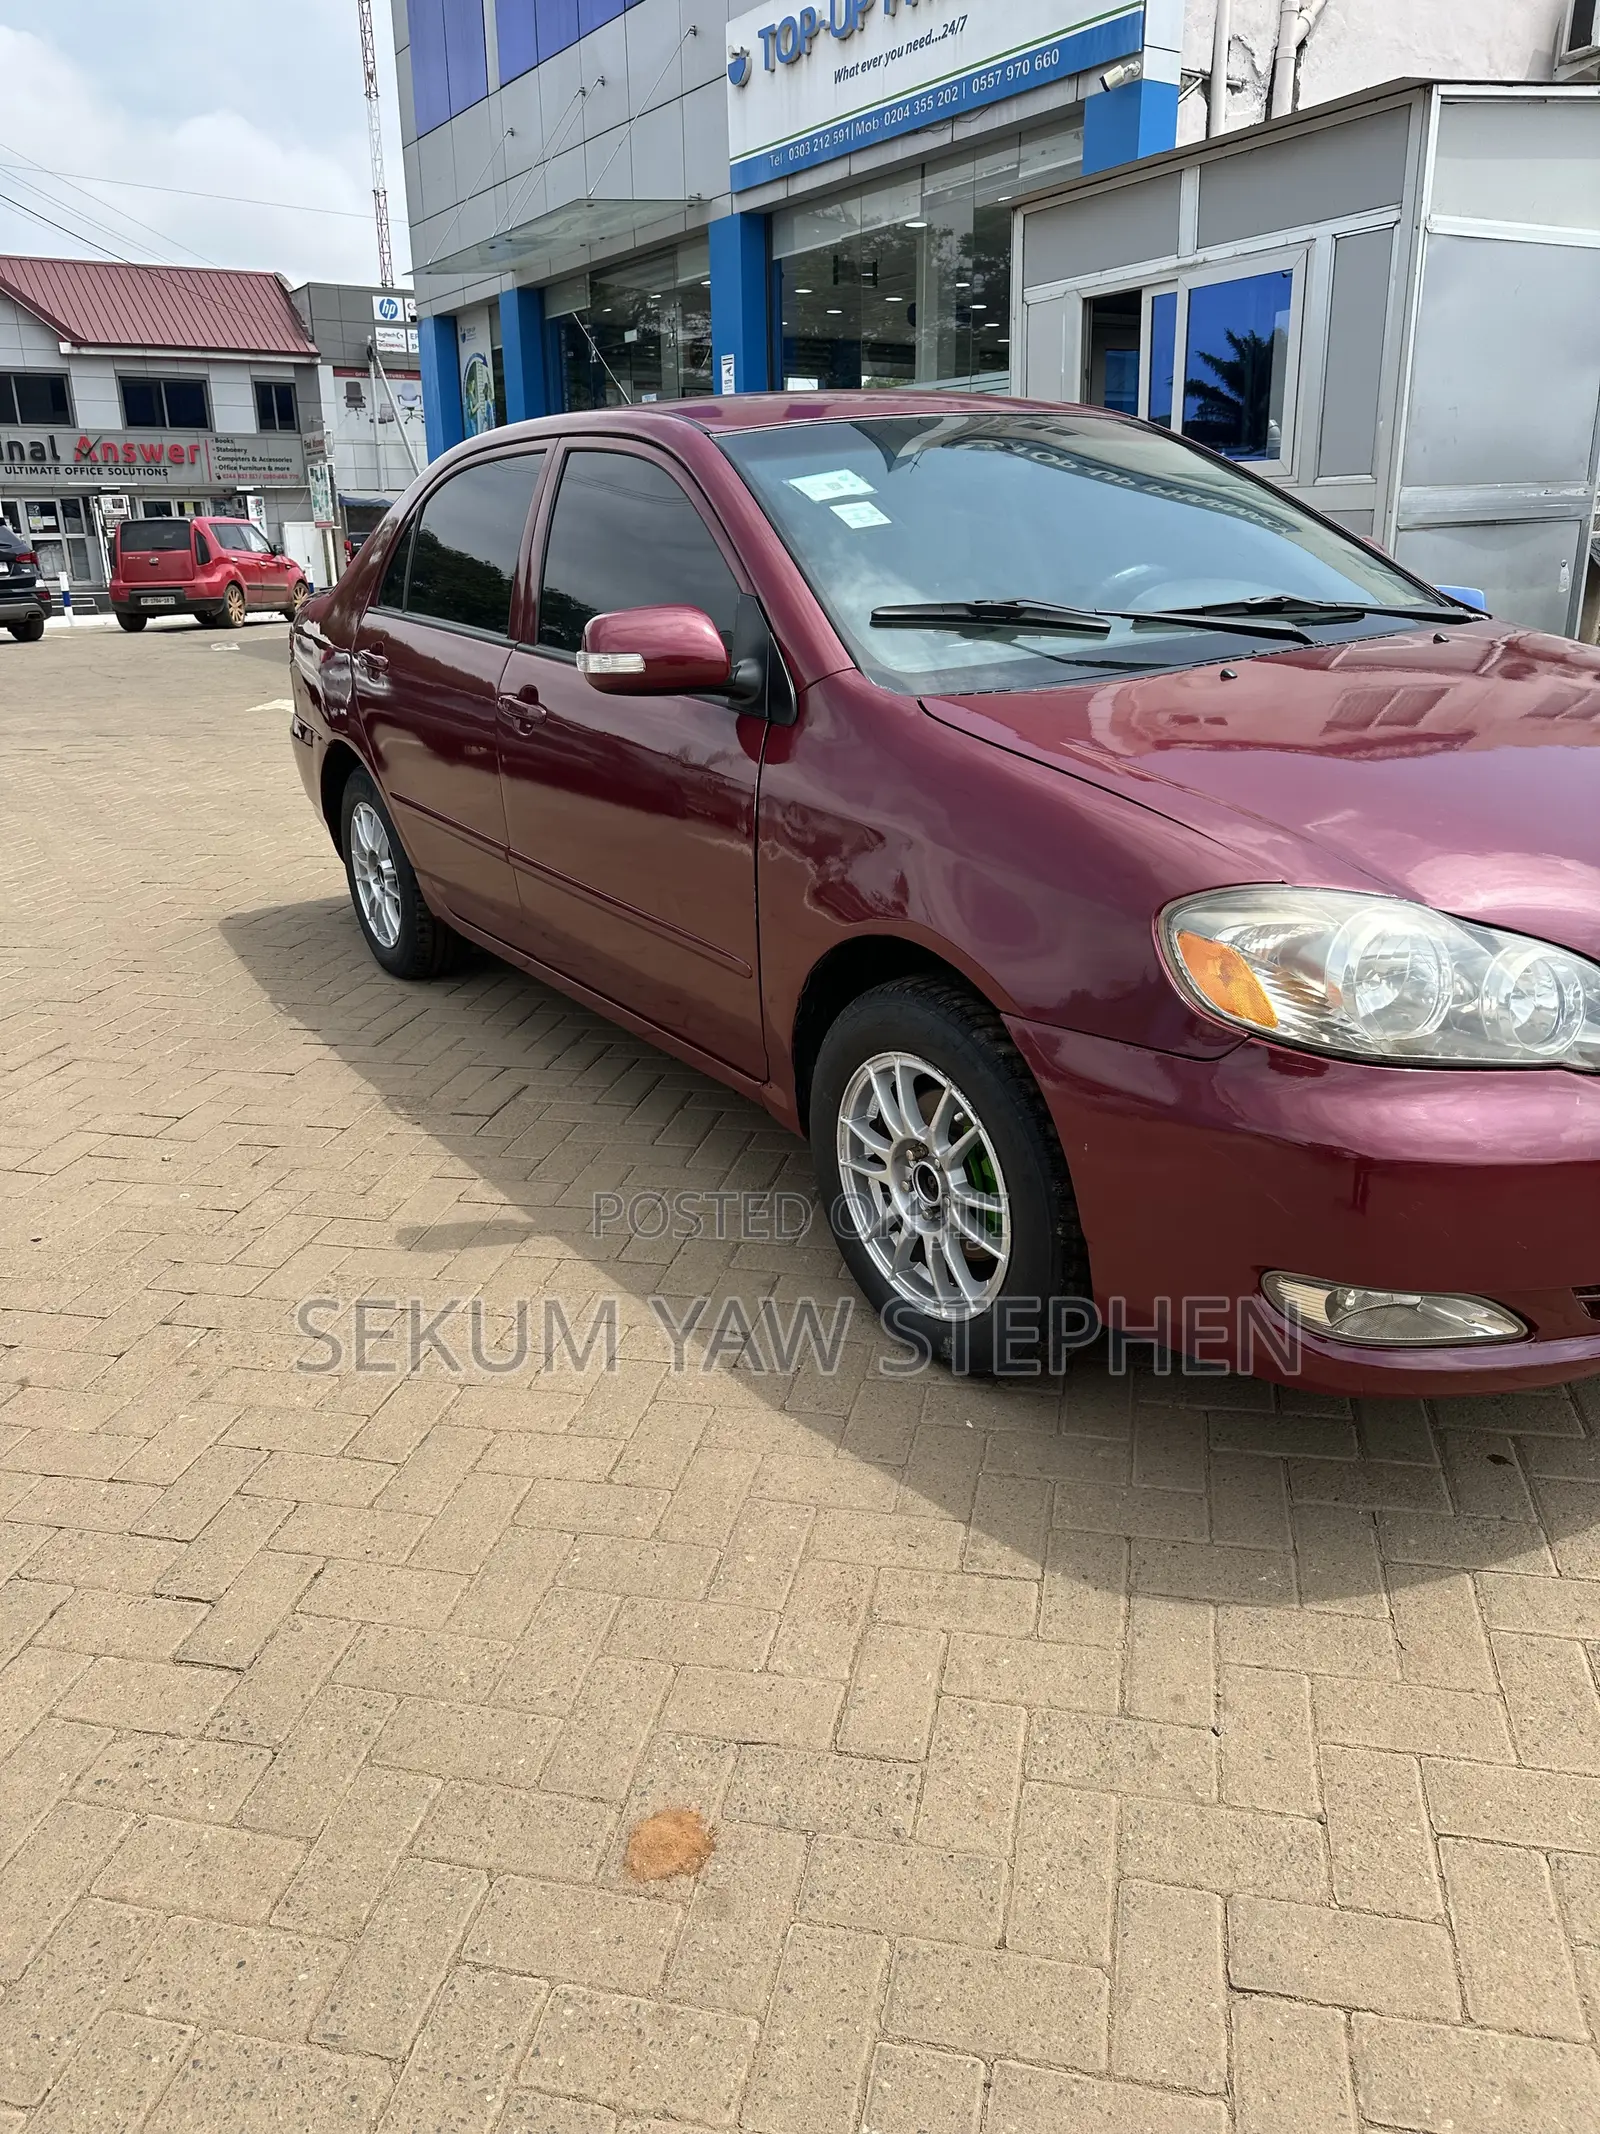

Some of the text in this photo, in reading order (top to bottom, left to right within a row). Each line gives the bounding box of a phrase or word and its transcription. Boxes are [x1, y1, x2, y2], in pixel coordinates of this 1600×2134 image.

[757, 0, 874, 72] TOP-UP
[834, 62, 860, 84] What
[860, 55, 884, 73] ever
[884, 47, 905, 67] you
[788, 141, 811, 161] 0303
[813, 134, 830, 152] 212
[884, 104, 910, 126] 0204
[913, 95, 934, 115] 355
[937, 86, 958, 106] 202
[972, 69, 1002, 94] 0557
[1006, 59, 1030, 81] 970
[1034, 48, 1060, 71] 660
[74, 435, 201, 465] Answer
[4, 465, 169, 477] ULTIMATE OFFICE SOLUTIONS
